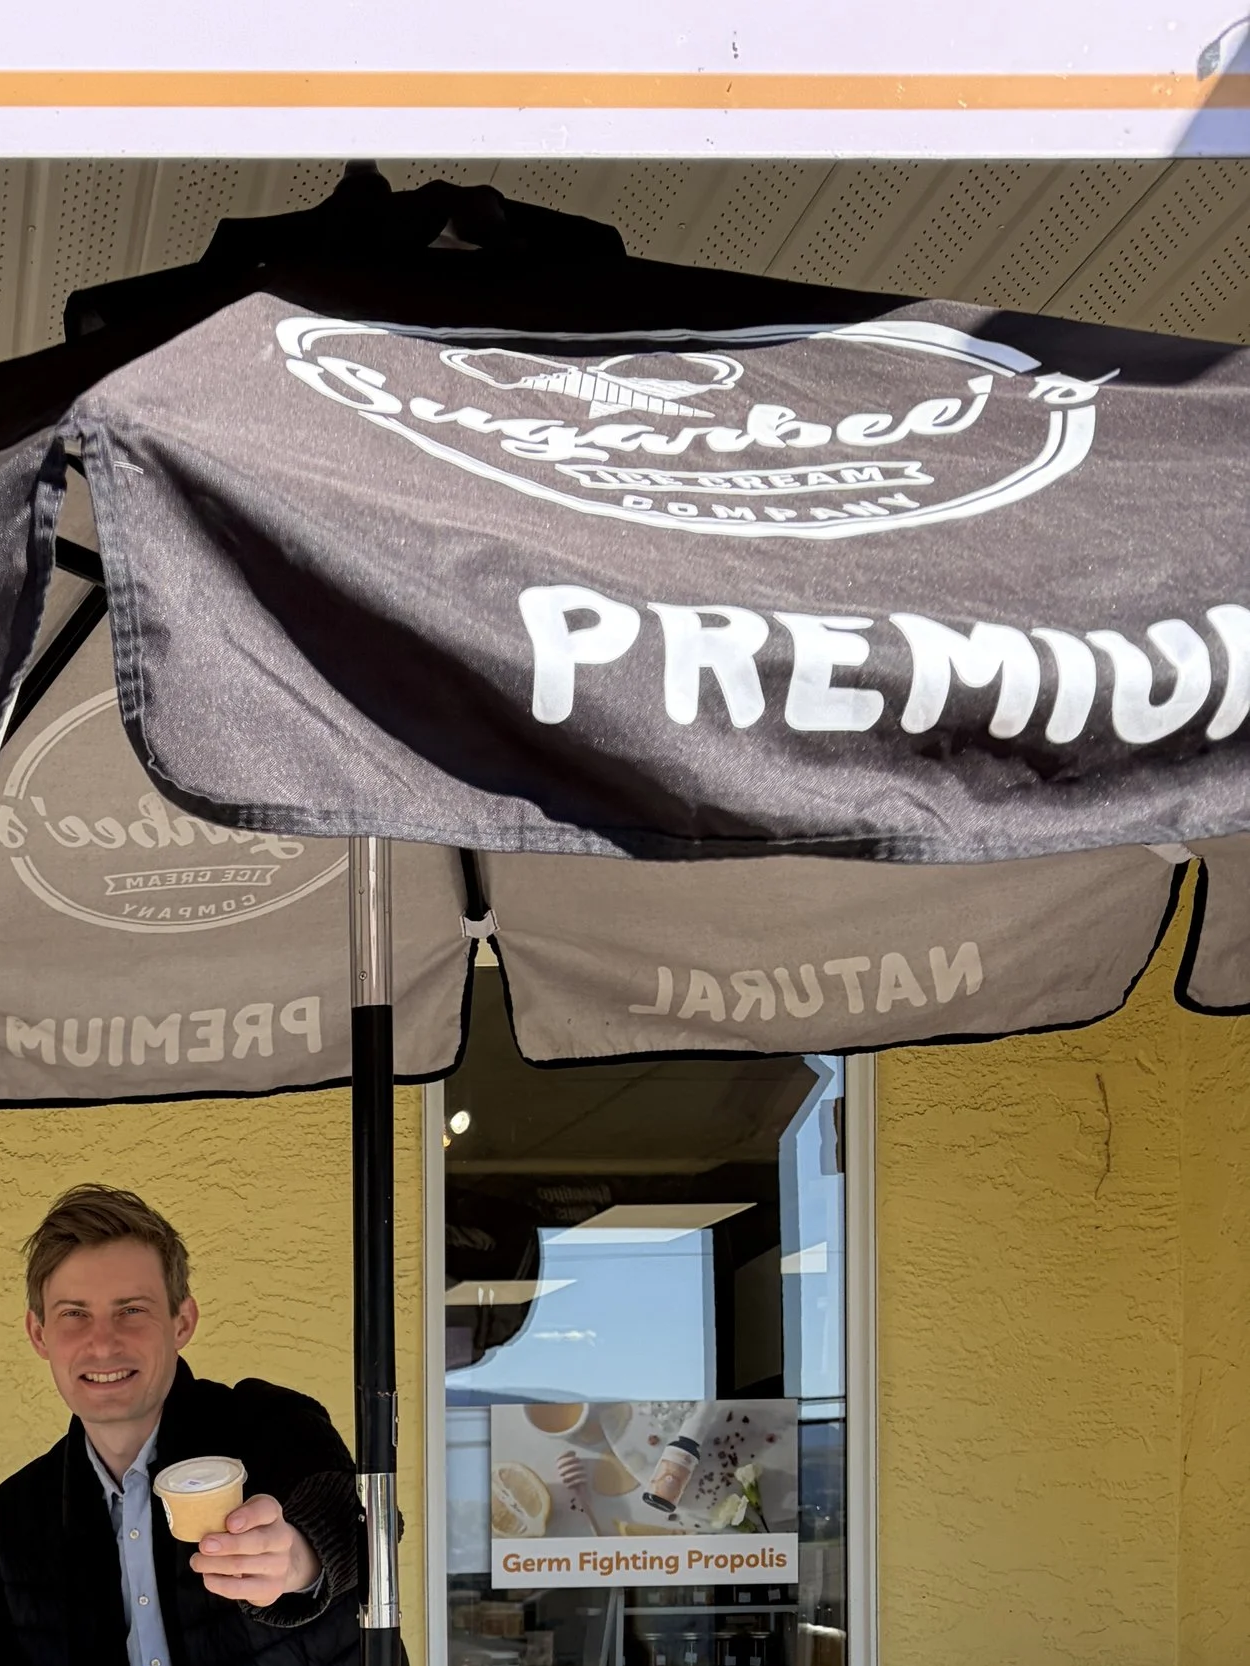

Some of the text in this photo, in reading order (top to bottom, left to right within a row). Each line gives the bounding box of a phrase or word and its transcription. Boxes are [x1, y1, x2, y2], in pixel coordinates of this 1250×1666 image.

[697, 466, 884, 489] CREAM
[622, 492, 920, 522] COMPANY
[502, 1548, 788, 1576] Germ Fighting Propolis
